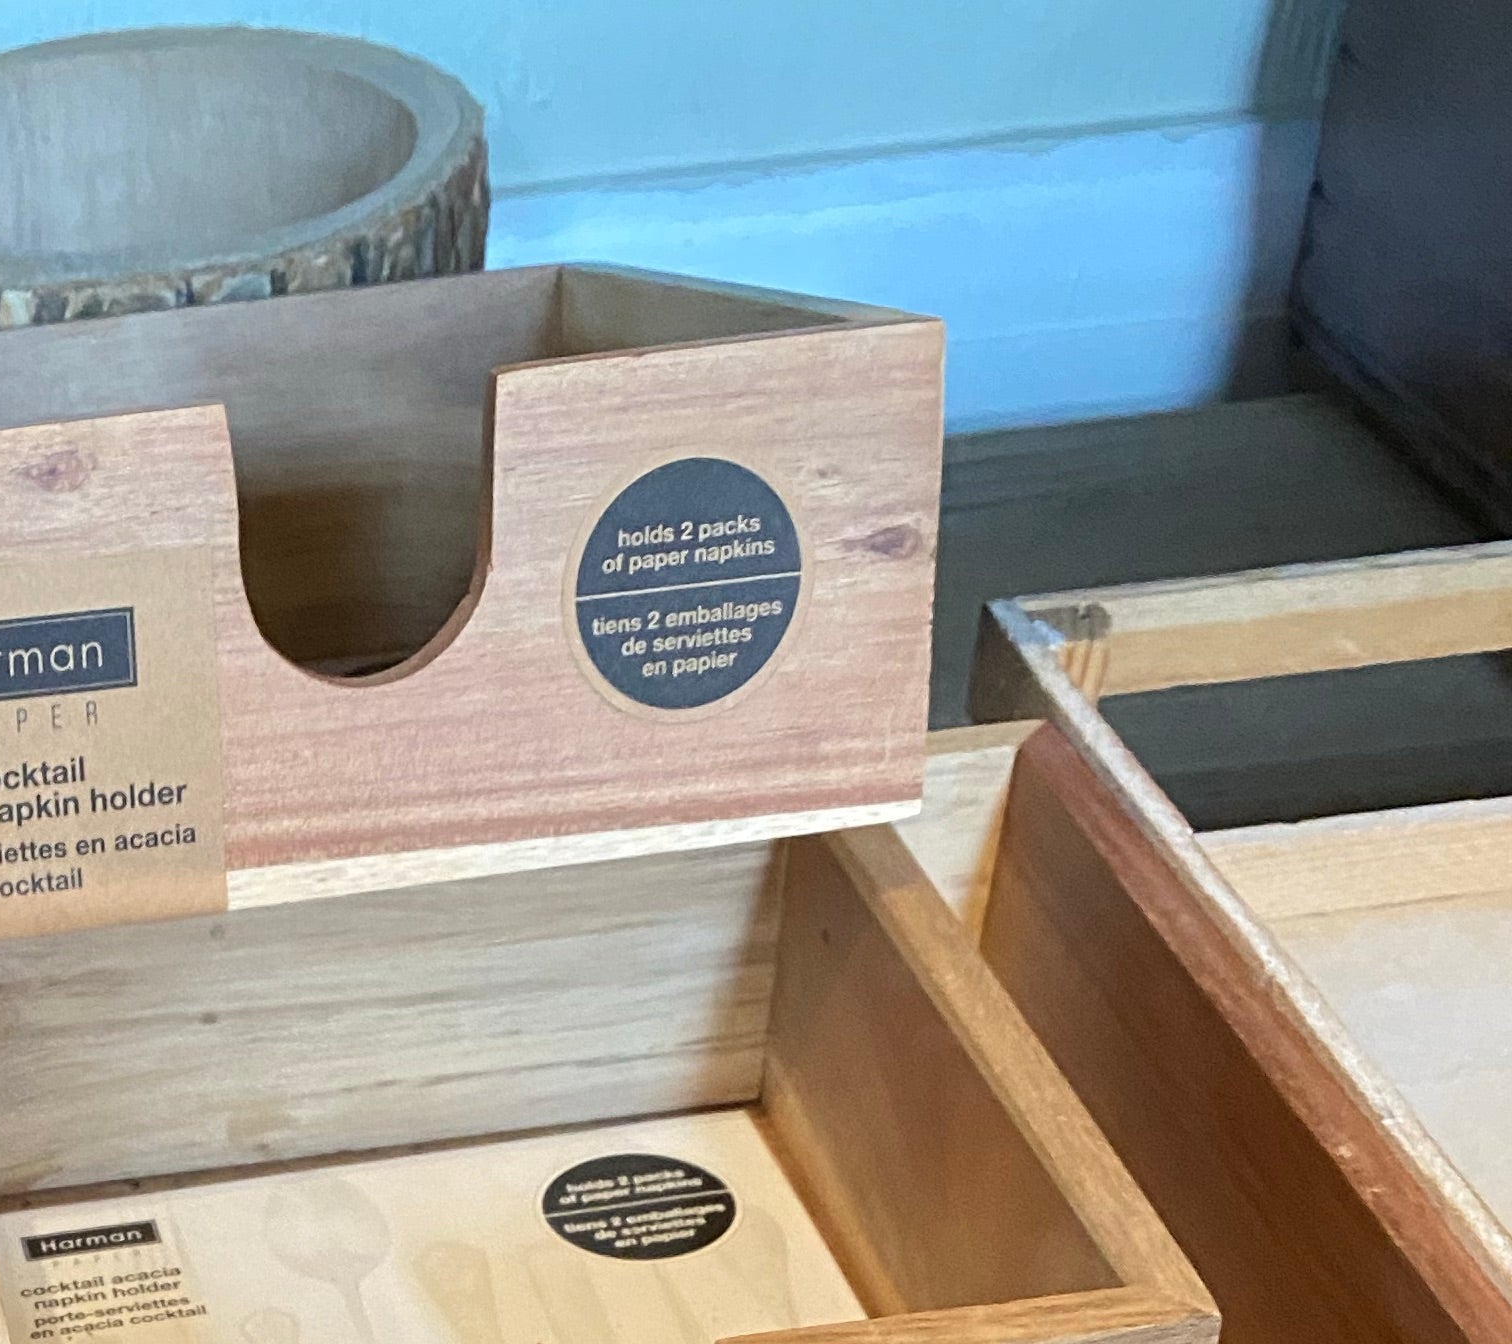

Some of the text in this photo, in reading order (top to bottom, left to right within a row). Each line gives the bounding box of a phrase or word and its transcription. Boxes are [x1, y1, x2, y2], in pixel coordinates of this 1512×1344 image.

[618, 515, 761, 548] holds 2 packs
[602, 537, 775, 574] of paper napkins
[592, 600, 783, 635] tiens 2 emballages
[621, 626, 753, 656] de serviettes
[642, 652, 738, 677] en papier
[90, 780, 187, 813] holder
[75, 837, 106, 857] en
[114, 825, 197, 851] acacia
[41, 1230, 142, 1252] Harman
[20, 1265, 181, 1298] cocktail acacia
[34, 1280, 182, 1311] napkin holder
[30, 1304, 207, 1340] en acacia cocktail
[34, 1296, 191, 1328] porte-serviettes
